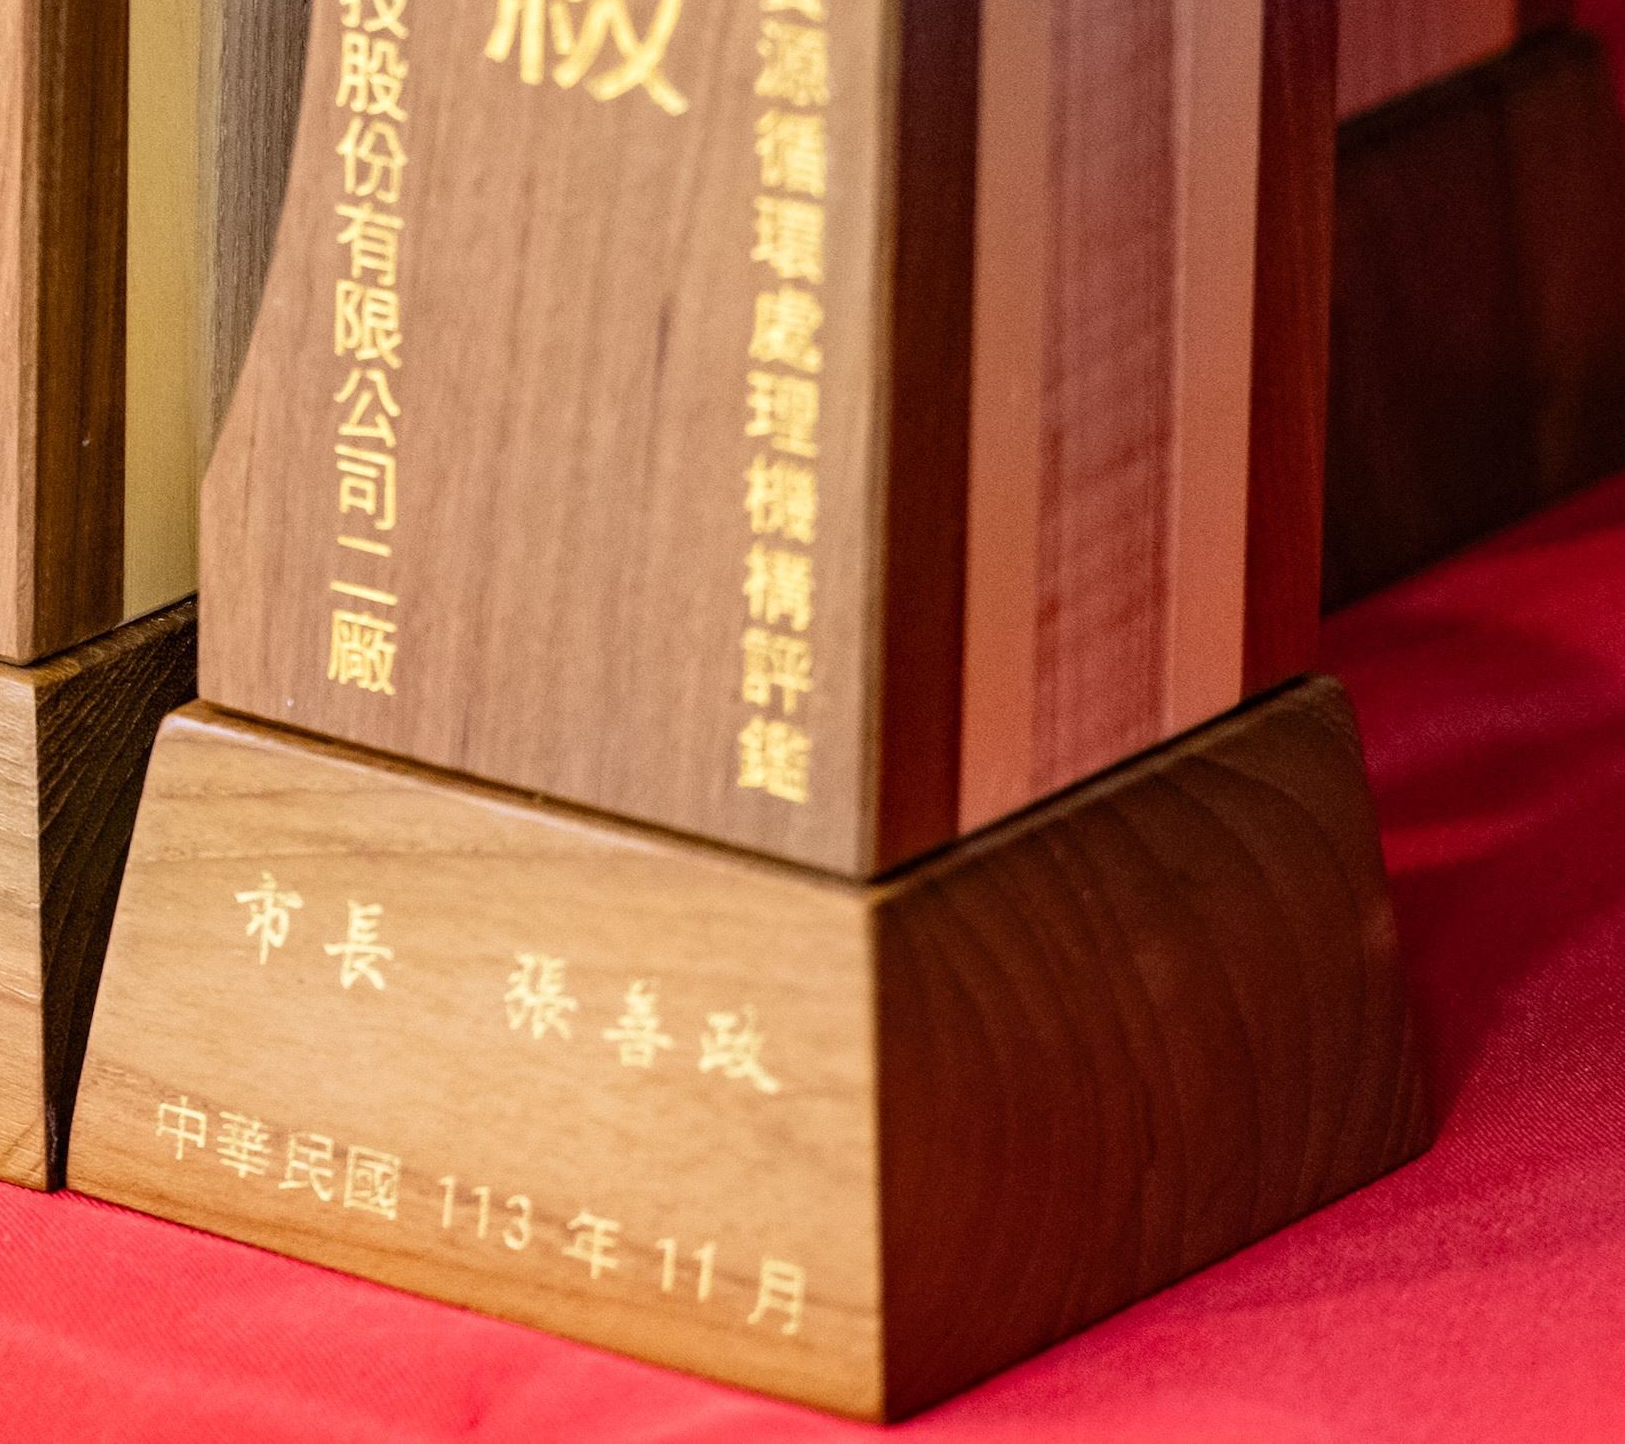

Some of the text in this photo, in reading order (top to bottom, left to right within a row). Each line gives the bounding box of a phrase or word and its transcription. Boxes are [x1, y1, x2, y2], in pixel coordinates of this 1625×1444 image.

[236, 871, 780, 1093] 市長 張善政
[154, 1096, 805, 1336] 中華民國 113 年 11 月
